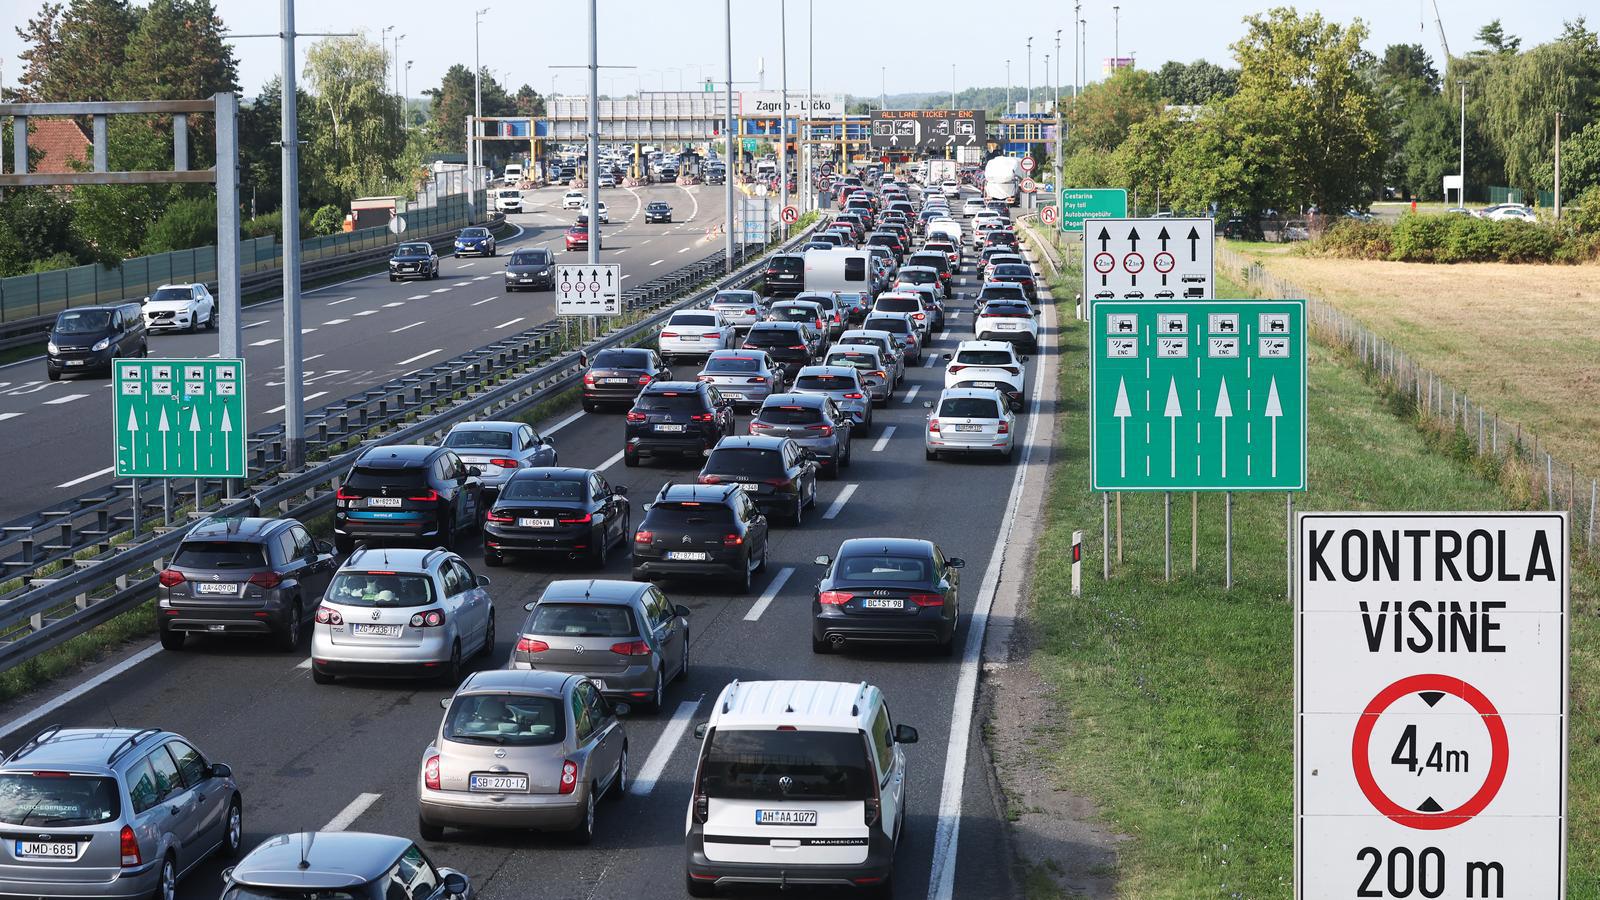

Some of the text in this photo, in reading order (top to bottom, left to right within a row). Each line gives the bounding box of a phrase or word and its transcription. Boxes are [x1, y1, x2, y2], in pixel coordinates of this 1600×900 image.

[1308, 528, 1556, 583] KONTROLA
[1358, 600, 1507, 654] VISINE
[1391, 724, 1469, 777] 4,4m
[477, 778, 488, 787] SB
[762, 812, 815, 822] AH AA 1077
[24, 843, 74, 855] JMD-685
[1356, 846, 1504, 899] 200 m
